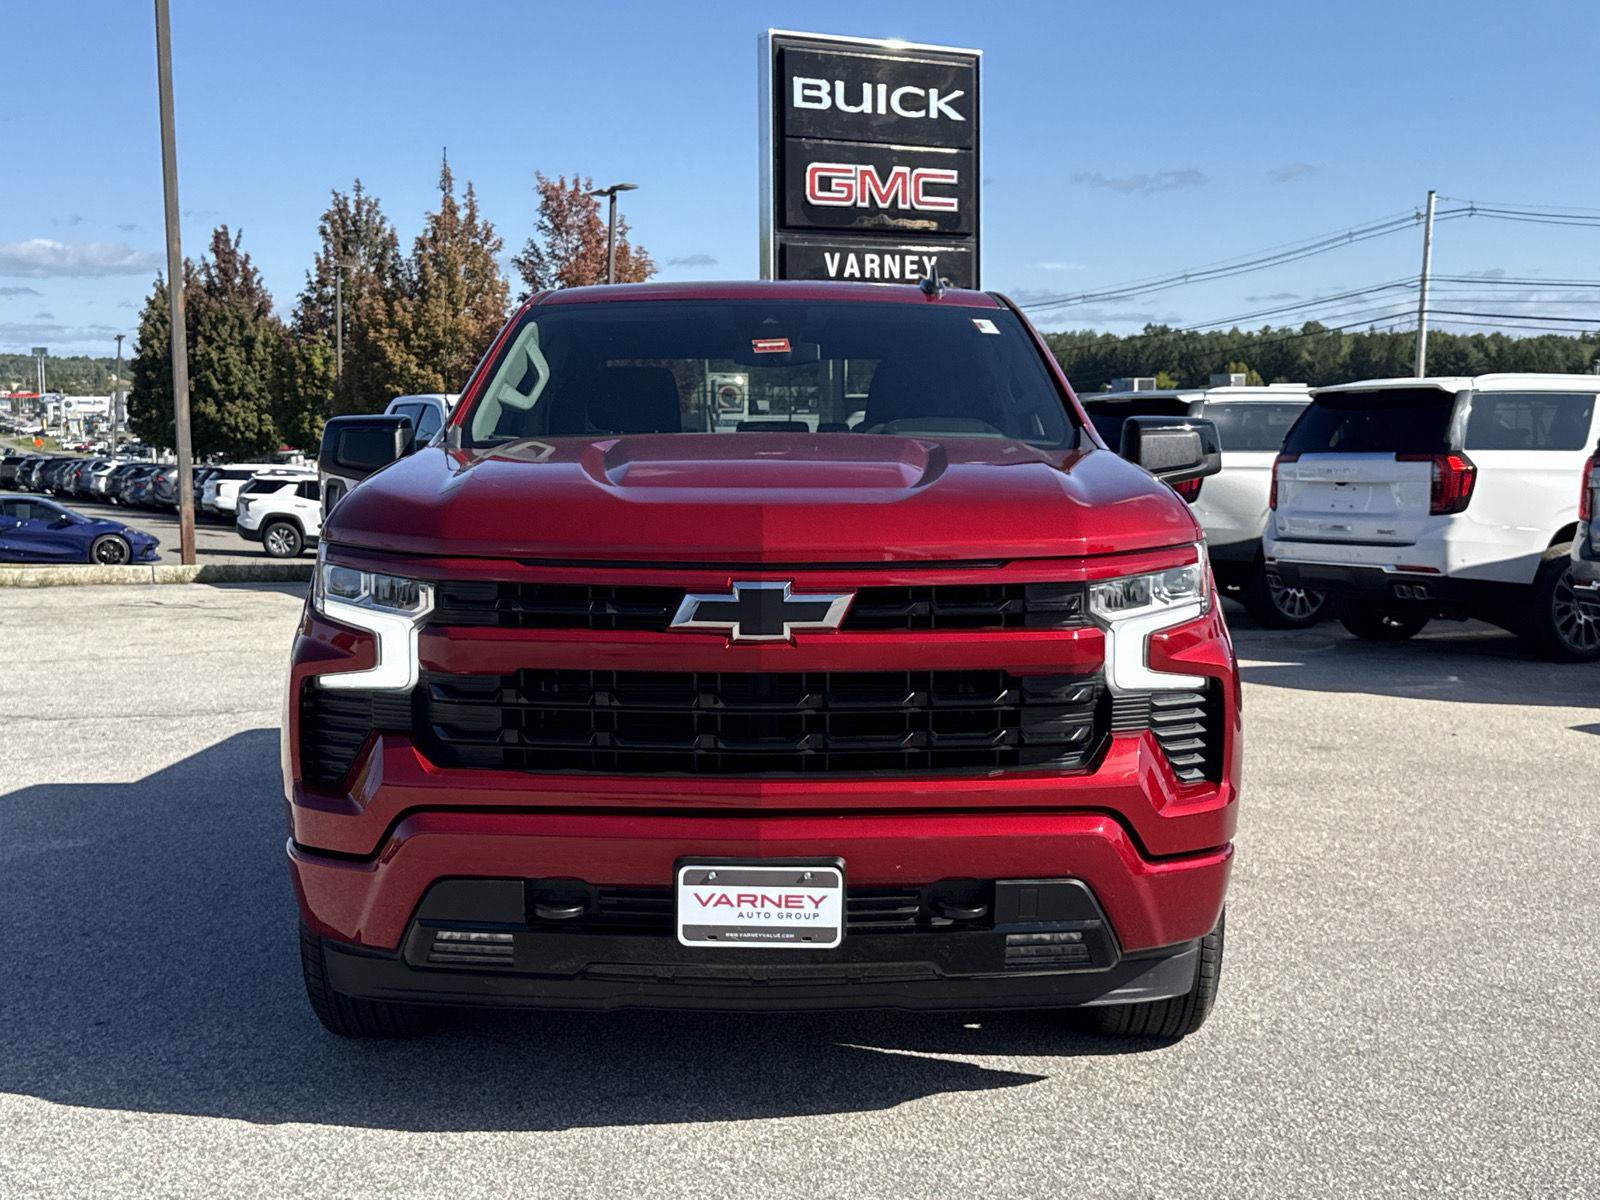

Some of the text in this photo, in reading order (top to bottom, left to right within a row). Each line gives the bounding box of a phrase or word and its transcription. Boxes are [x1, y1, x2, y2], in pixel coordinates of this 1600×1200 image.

[793, 76, 966, 121] BUICK
[806, 162, 959, 212] GMC
[824, 252, 938, 280] VARNEY
[693, 893, 828, 909] VARNEY
[737, 911, 820, 920] AUTO GROUP
